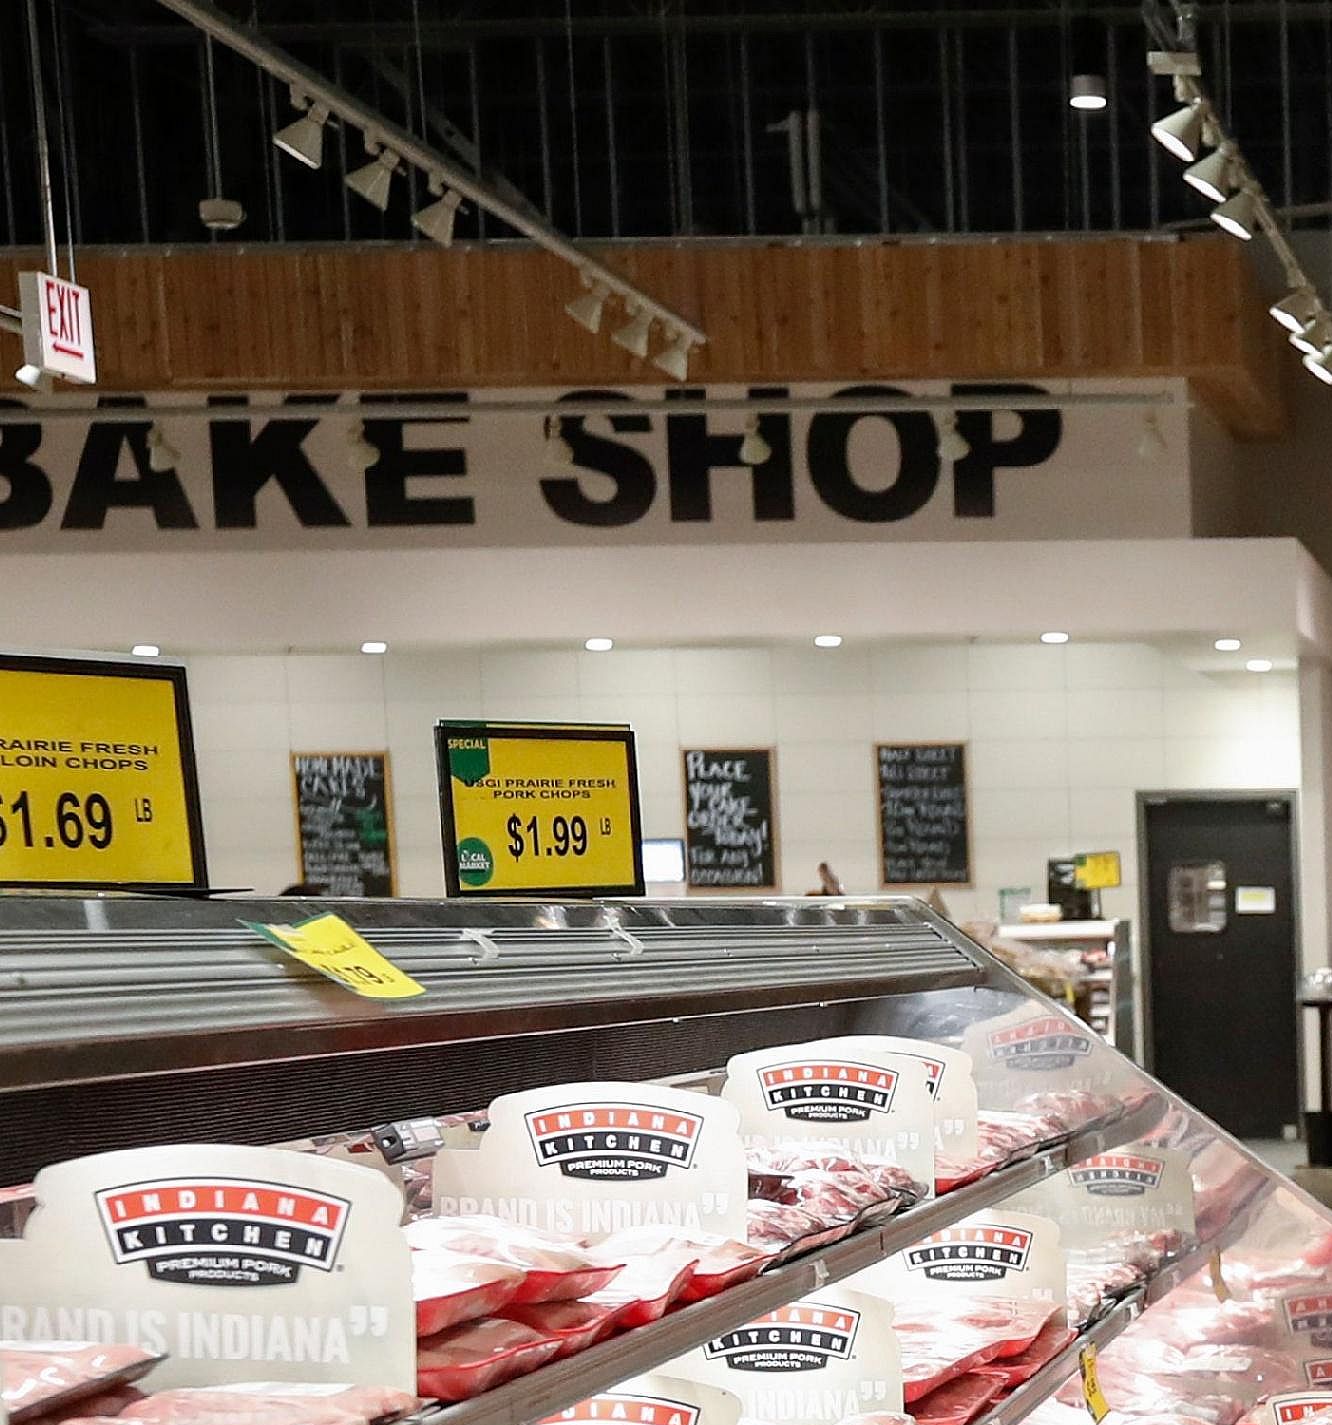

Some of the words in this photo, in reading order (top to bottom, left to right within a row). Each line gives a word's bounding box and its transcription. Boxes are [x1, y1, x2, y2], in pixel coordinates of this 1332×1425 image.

[46, 280, 80, 346] EXIT
[538, 384, 1063, 527] SHOP
[80, 742, 158, 756] FRESH
[447, 738, 487, 750] SPECIAL
[65, 757, 149, 771] CHOPS
[505, 778, 565, 789] PRAIRIE
[568, 778, 616, 789] FRESH
[493, 789, 536, 800] PORK
[539, 789, 592, 800] CHOPS
[0, 790, 113, 850] 1.69
[135, 797, 153, 824] LB
[507, 812, 588, 863] $1.99
[599, 817, 612, 836] LB
[459, 860, 491, 870] MARKET
[460, 849, 487, 862] LOCAL
[766, 1066, 887, 1087] INDIANA
[772, 1083, 885, 1105] KITCHEN
[790, 1105, 838, 1115] PREMIUM
[838, 1105, 866, 1118] PORK
[539, 1110, 688, 1135] INDIANA
[544, 1134, 684, 1158] KITCHEN
[567, 1159, 626, 1171] PREMIUM
[627, 1159, 662, 1174] PORK
[590, 1168, 639, 1177] PRODUCTS
[116, 1189, 330, 1226] INDIANA
[122, 1222, 326, 1258] KITCHEN
[912, 1246, 1019, 1265] KITCHEN
[156, 1256, 239, 1273] PREMIUM
[242, 1258, 292, 1279] PORK
[188, 1269, 261, 1282] PRODUCTS
[930, 1264, 974, 1275] PREMIUM
[974, 1263, 1003, 1275] PORK
[770, 1309, 846, 1329] IANA
[126, 1307, 167, 1356] IS
[711, 1330, 843, 1351] KITCHEN
[733, 1353, 788, 1365] PREMIUM
[789, 1353, 823, 1365] PORK
